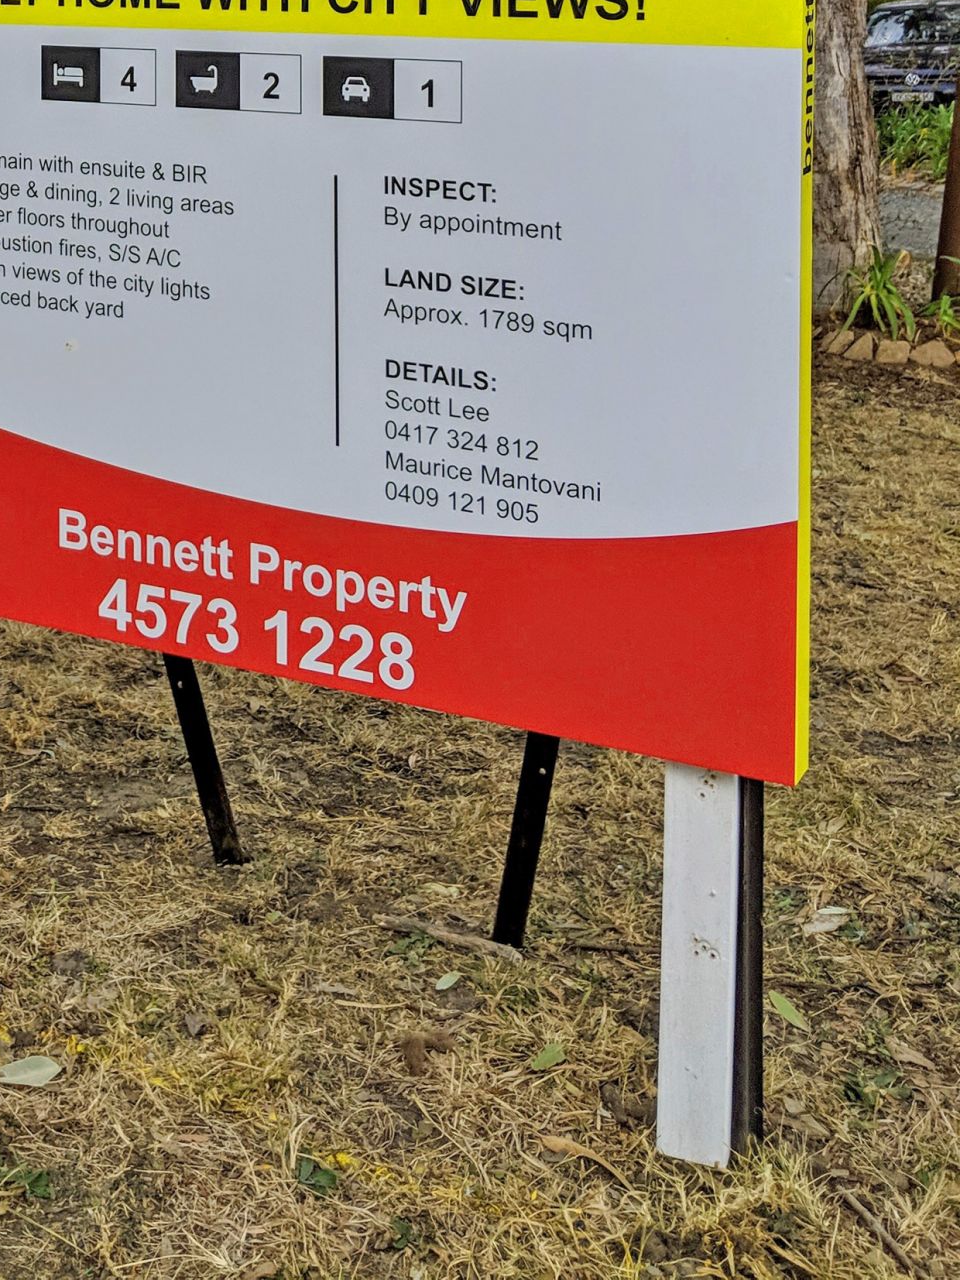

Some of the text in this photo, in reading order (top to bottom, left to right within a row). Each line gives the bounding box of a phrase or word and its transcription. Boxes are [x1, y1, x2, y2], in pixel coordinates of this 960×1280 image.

[120, 66, 138, 92] 4
[262, 72, 280, 100] 2
[421, 79, 434, 108] 1
[39, 156, 74, 174] with
[80, 161, 146, 180] ensuite
[152, 162, 166, 181] &
[172, 163, 208, 184] BIR
[26, 180, 39, 199] &
[44, 182, 104, 208] dining,
[109, 187, 120, 206] 2
[126, 188, 174, 215] living
[180, 197, 235, 216] areas
[384, 175, 497, 204] INSPECT:
[17, 206, 65, 229] floors
[71, 212, 170, 239] throughout
[384, 205, 563, 241] By appointment
[58, 238, 102, 262] fires,
[108, 243, 141, 264] S/S
[145, 247, 181, 268] A/C
[12, 264, 61, 284] views
[66, 267, 85, 286] of
[89, 269, 117, 290] the
[123, 275, 155, 298] city
[161, 276, 211, 302] lights
[384, 267, 525, 301] LAND SIZE:
[37, 291, 79, 313] back
[84, 301, 125, 320] yard
[383, 298, 593, 343] Approx. 1789 sqm
[385, 358, 497, 392] DETAILS:
[384, 389, 490, 423] Scott Lee
[384, 419, 539, 461] 0417 324 812
[385, 450, 601, 502] Maurice Mantovani
[384, 481, 539, 524] 0409 121 905
[58, 507, 469, 634] Bennett Property
[97, 577, 416, 691] 4573 1228
